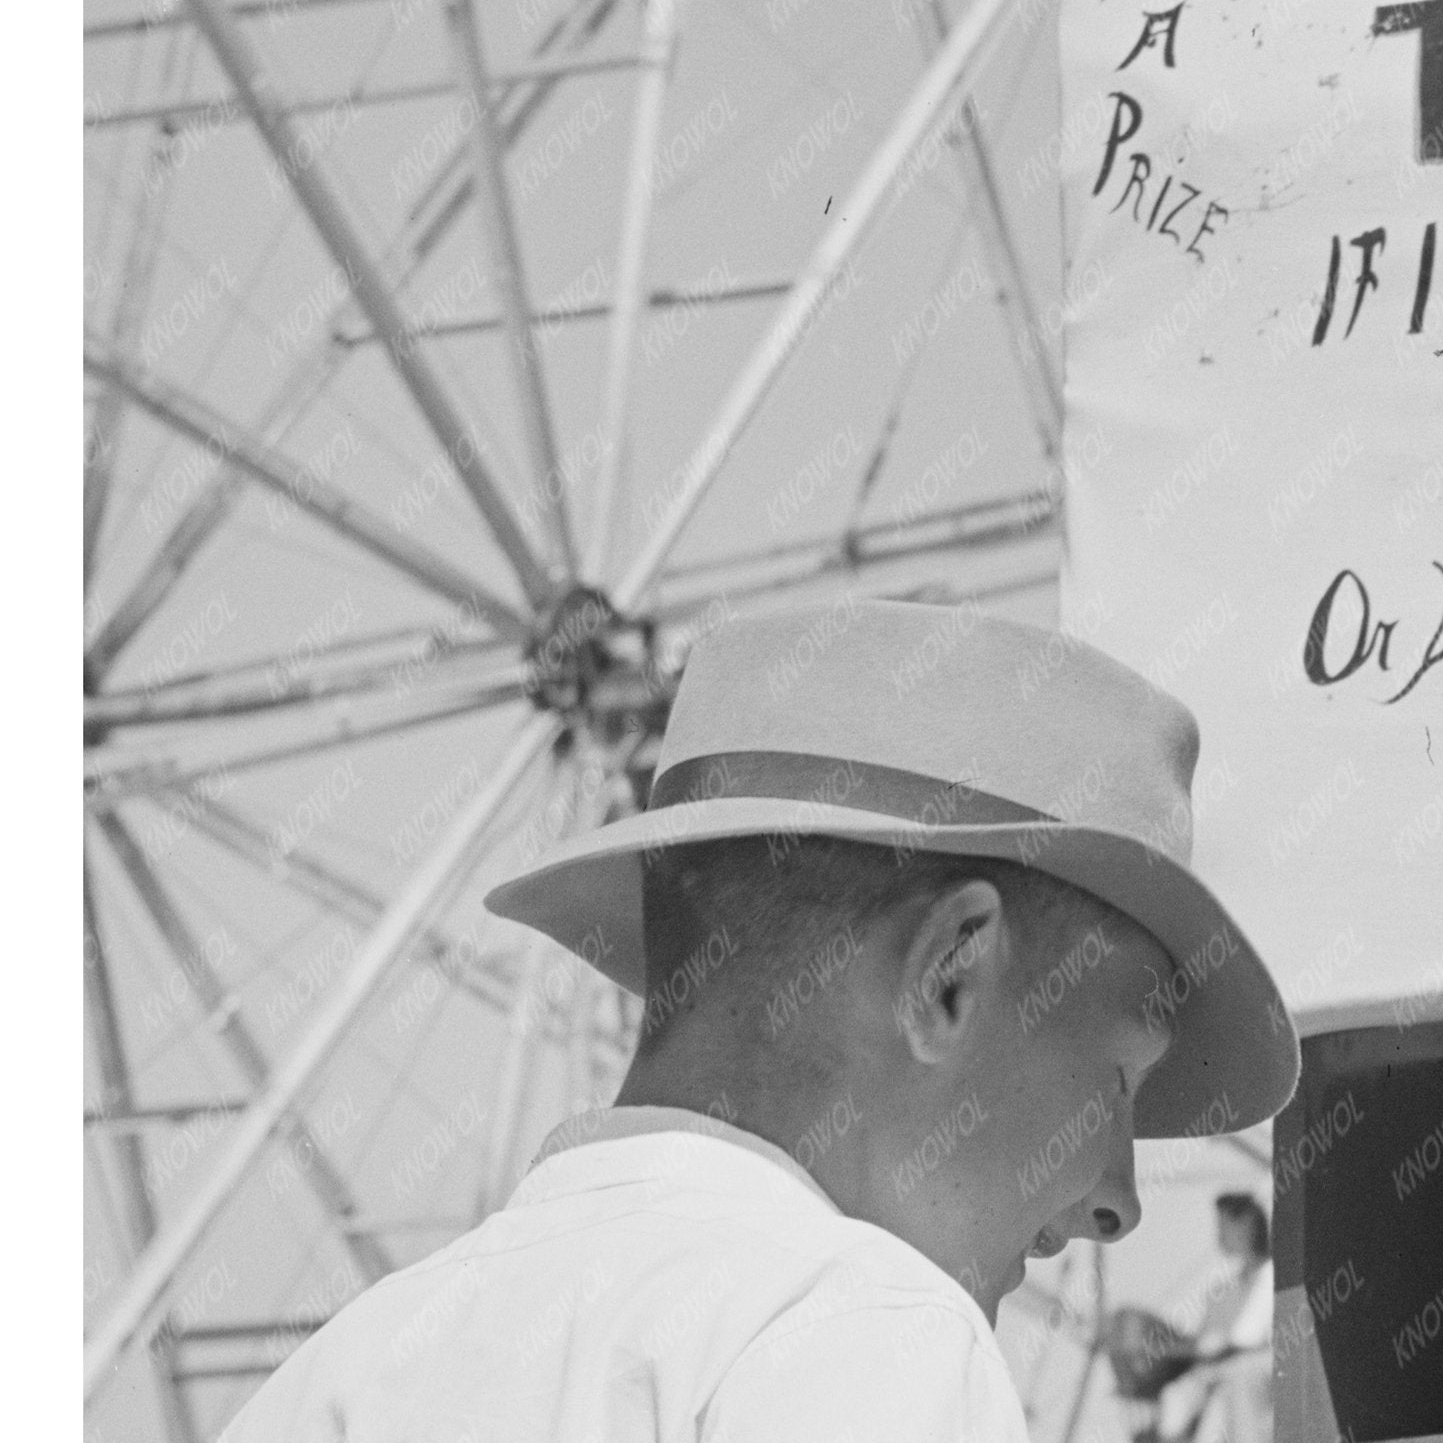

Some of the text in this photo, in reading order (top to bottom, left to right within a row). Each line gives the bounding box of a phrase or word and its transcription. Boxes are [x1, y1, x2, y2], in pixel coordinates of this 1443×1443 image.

[1114, 0, 1186, 72] A
[1408, 222, 1437, 335] I
[1302, 569, 1399, 686] Or
